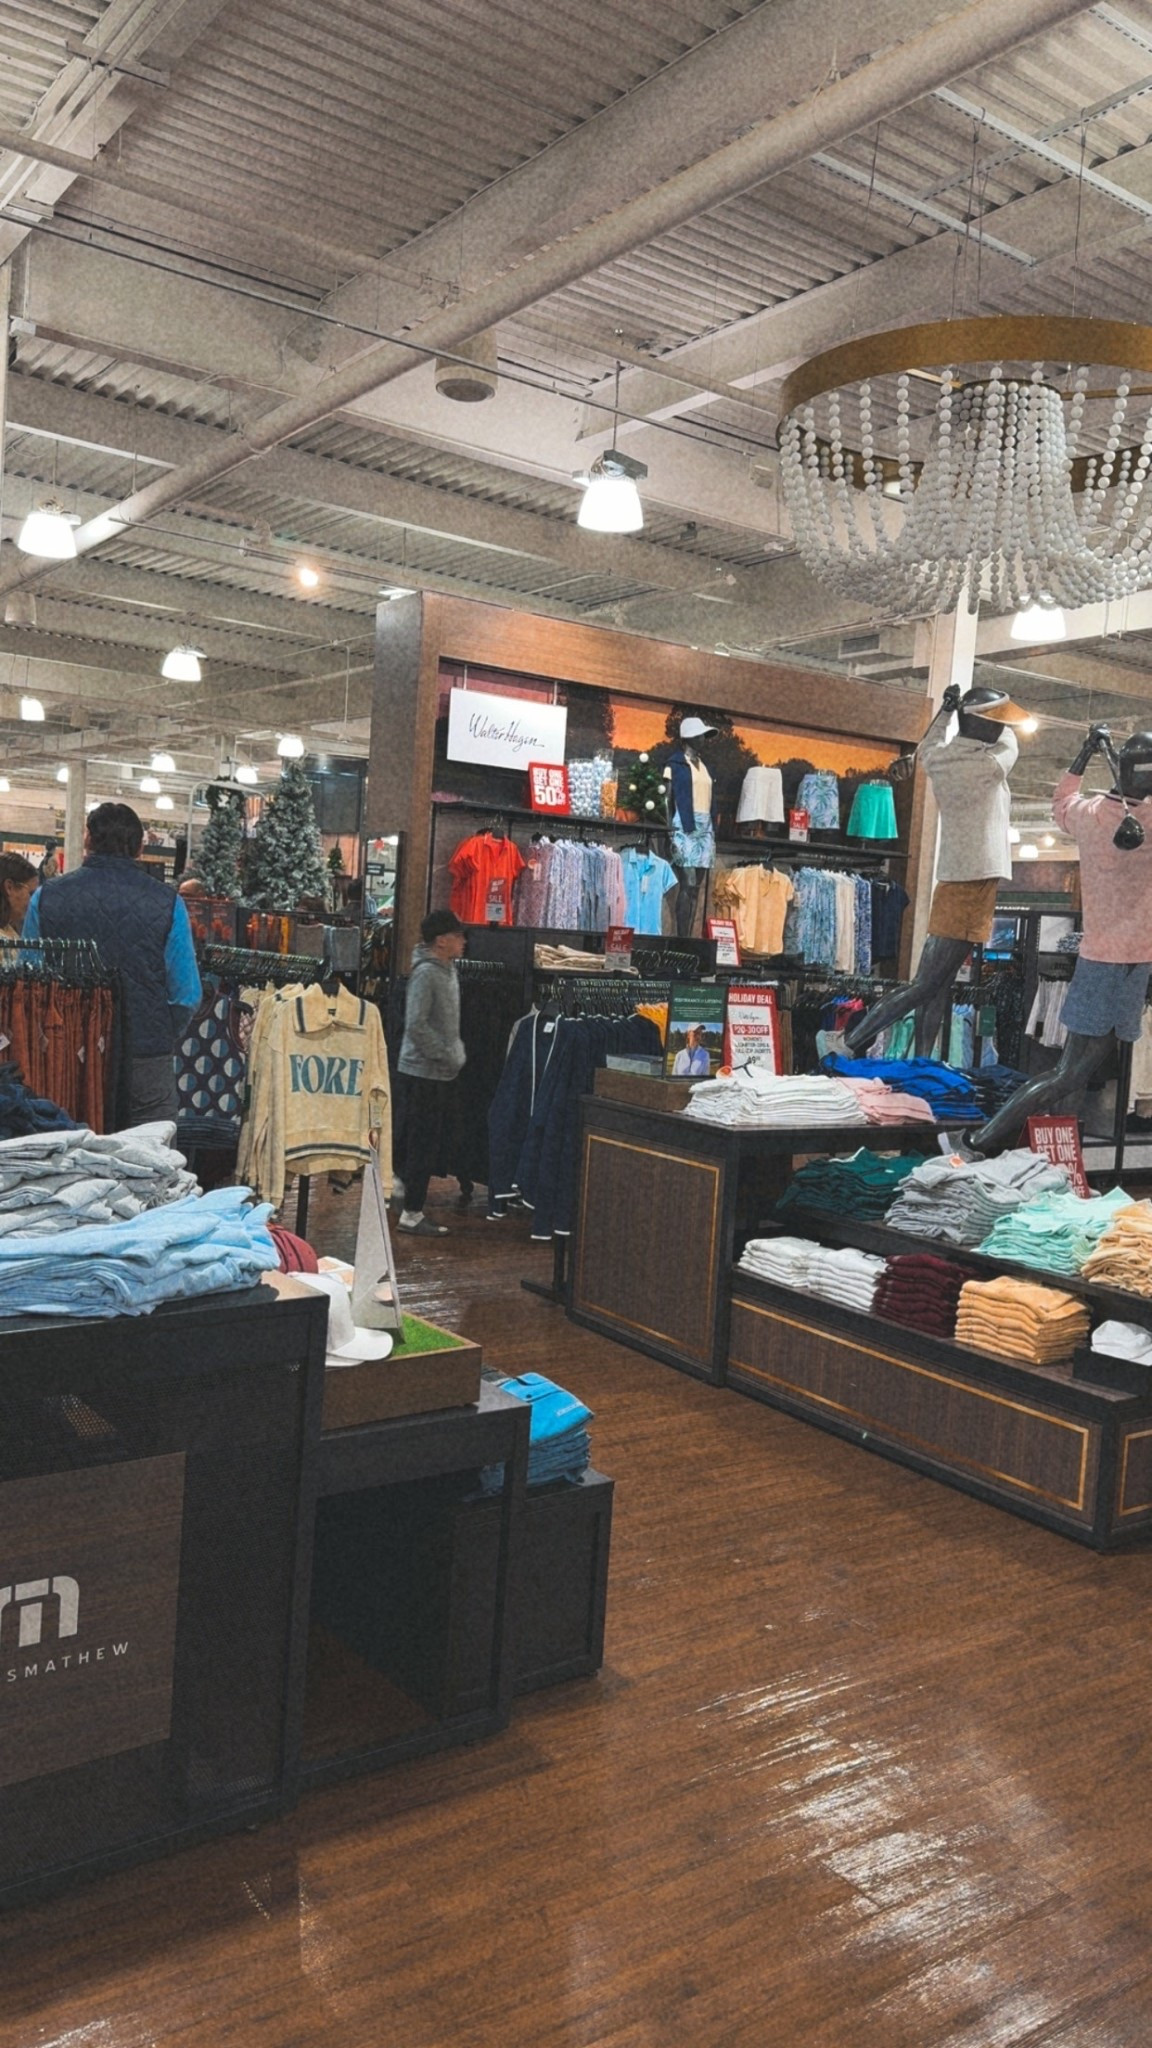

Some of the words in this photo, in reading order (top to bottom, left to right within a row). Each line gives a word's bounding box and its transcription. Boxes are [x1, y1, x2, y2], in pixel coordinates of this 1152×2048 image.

[468, 712, 504, 740] Walter
[504, 719, 545, 752] Hagen
[728, 993, 755, 1004] HOLIDAY
[756, 994, 773, 1005] DEAL
[756, 1026, 768, 1035] OFF
[289, 1054, 365, 1097] FORE
[1034, 1127, 1053, 1144] BUY
[1055, 1126, 1075, 1144] ONE
[1057, 1144, 1077, 1162] ONE
